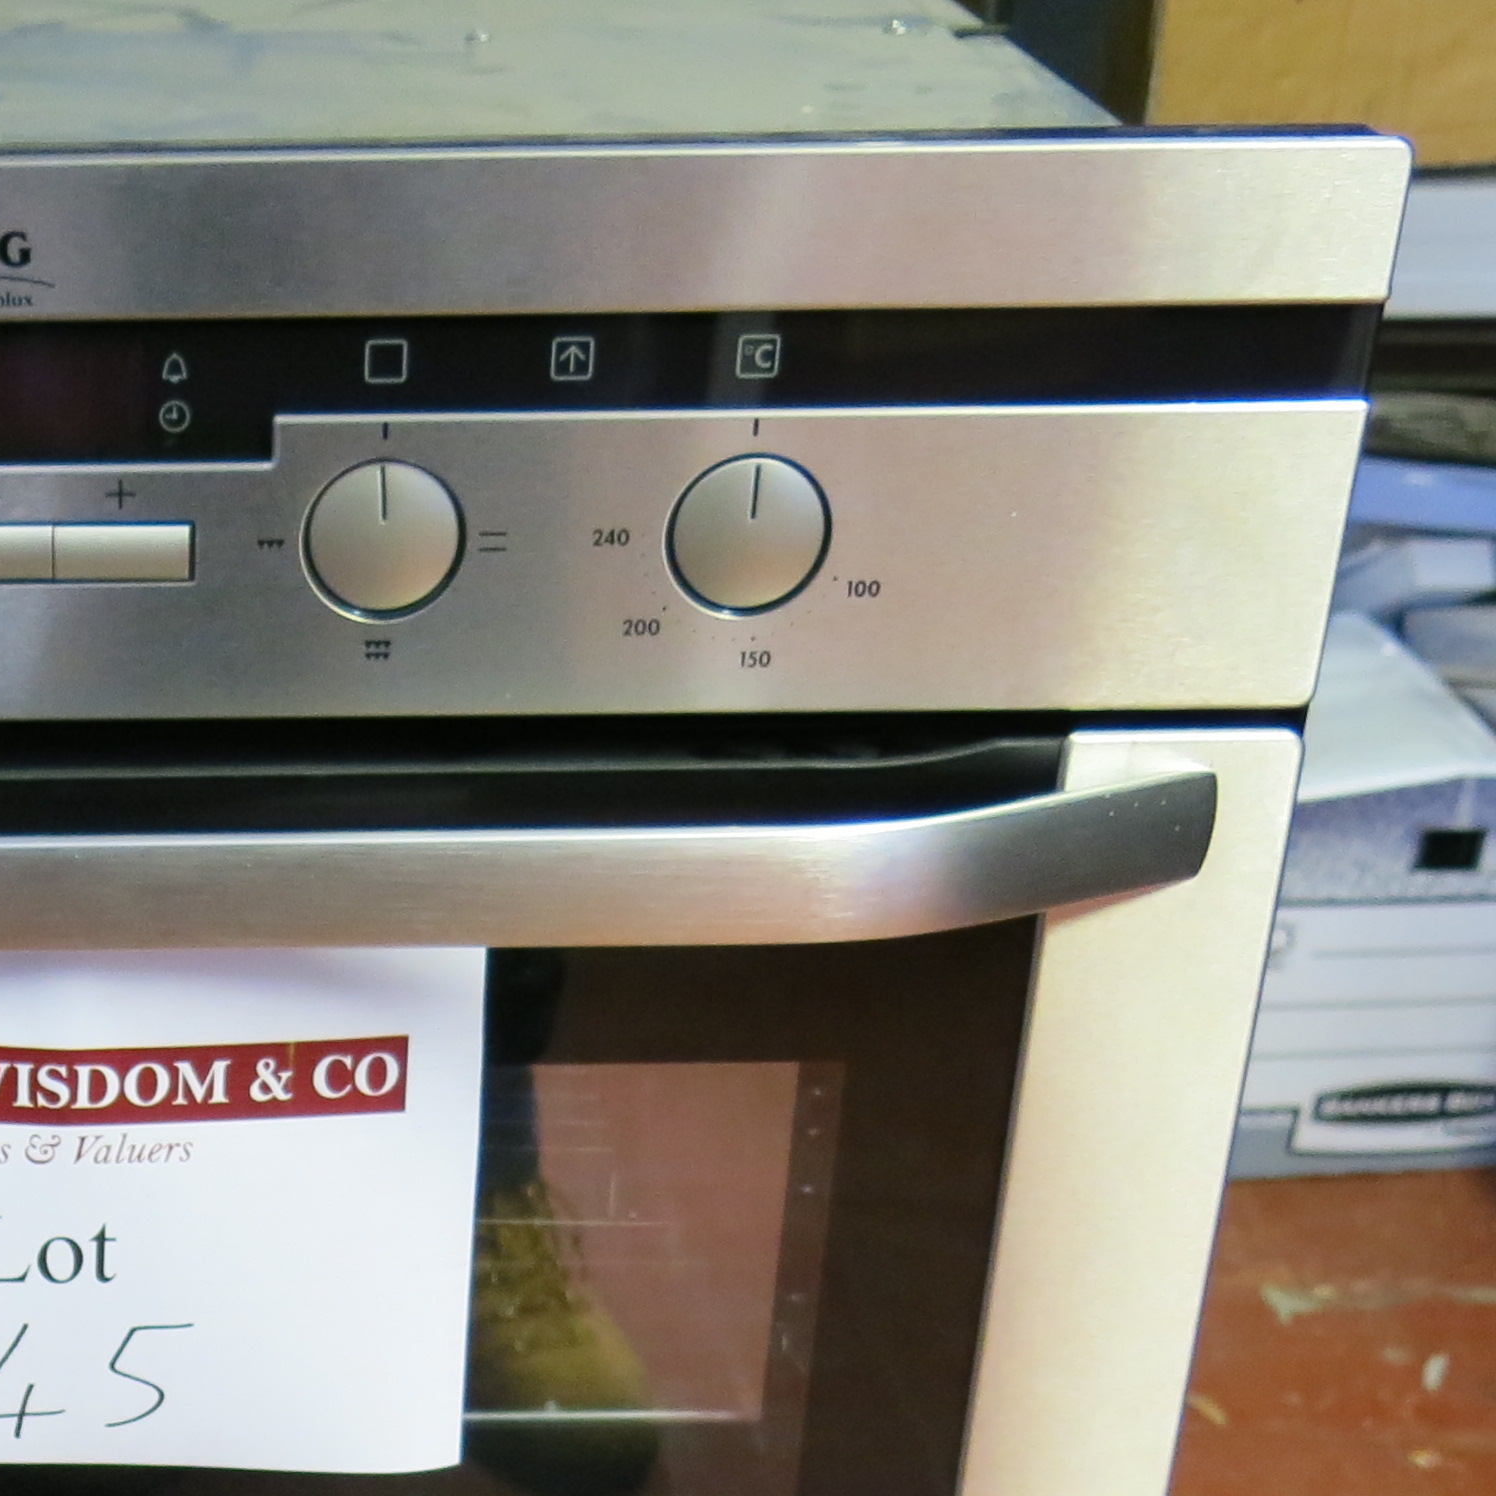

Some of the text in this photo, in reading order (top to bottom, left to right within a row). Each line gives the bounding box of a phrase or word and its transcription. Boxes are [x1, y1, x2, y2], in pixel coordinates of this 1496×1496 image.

[592, 529, 631, 549] 240
[846, 580, 882, 599] 100
[622, 618, 661, 638] 200
[739, 650, 772, 669] 150
[249, 1057, 295, 1102] &
[312, 1051, 400, 1100] CO
[24, 1134, 61, 1166] &
[72, 1132, 195, 1166] Valuers
